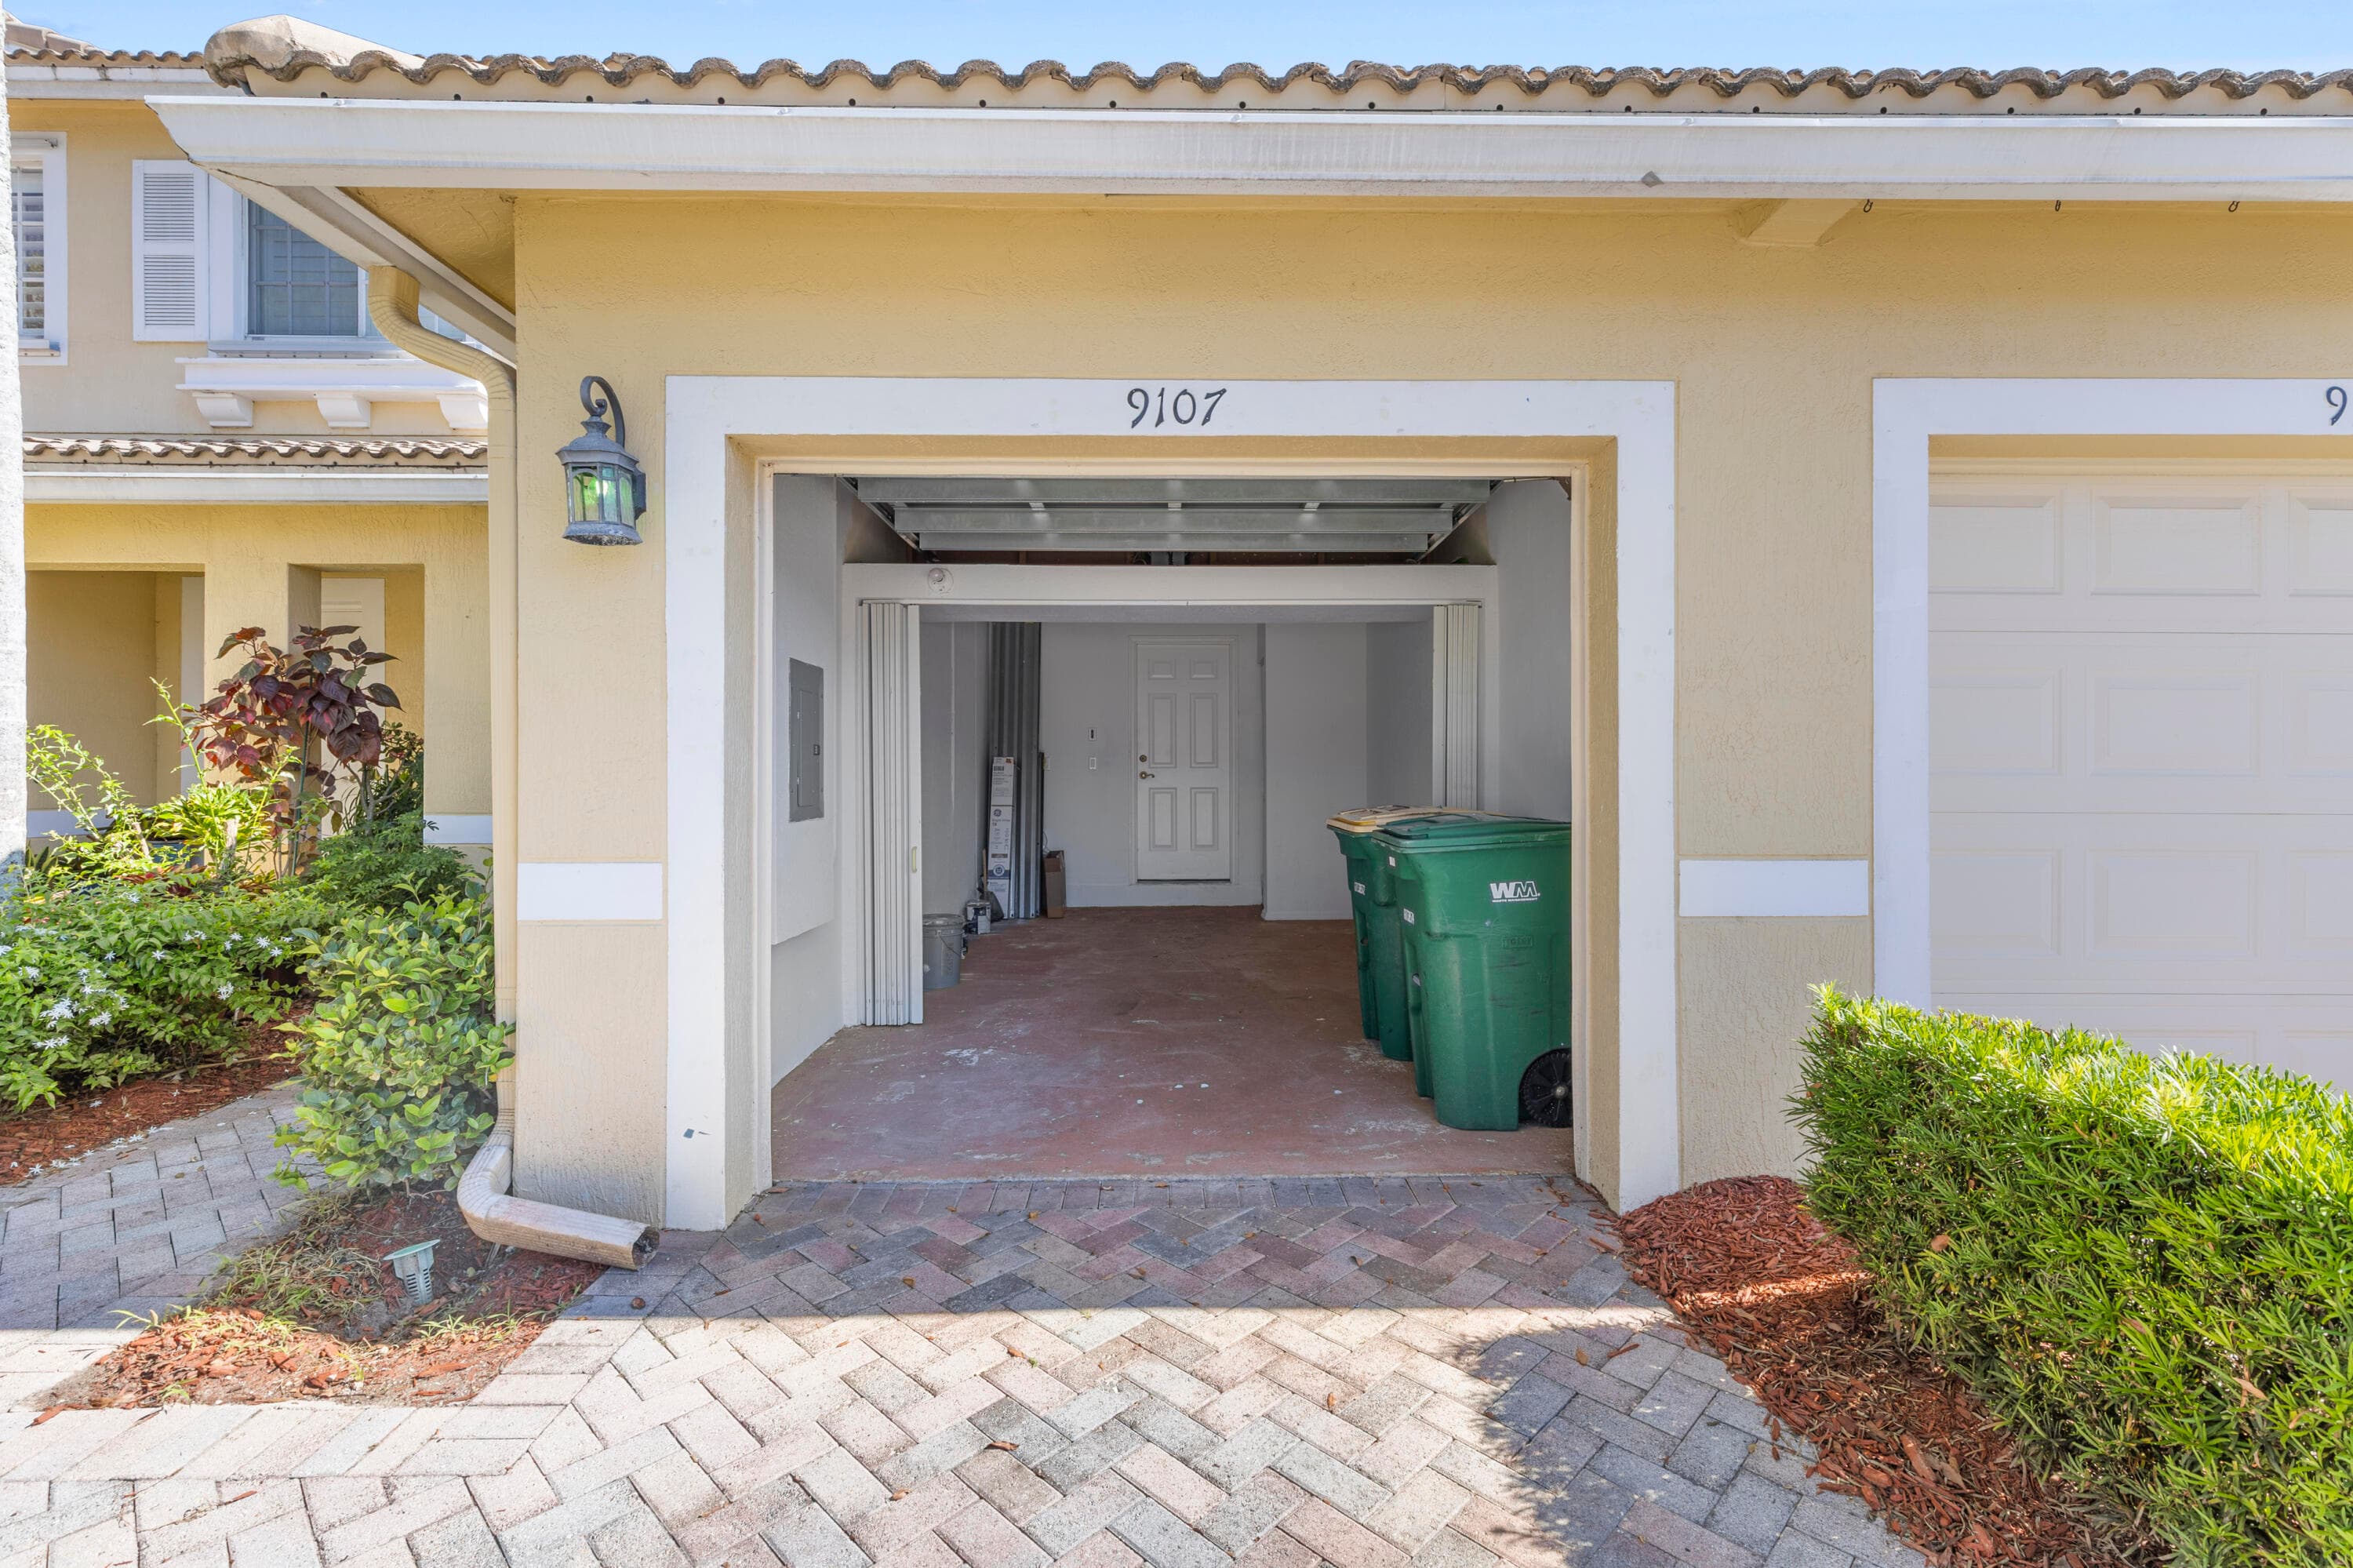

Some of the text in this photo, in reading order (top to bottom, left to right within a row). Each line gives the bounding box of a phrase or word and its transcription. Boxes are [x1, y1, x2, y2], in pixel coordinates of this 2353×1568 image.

[1127, 387, 1227, 429] 9107
[2326, 385, 2348, 426] 9
[1489, 881, 1538, 899] WM
